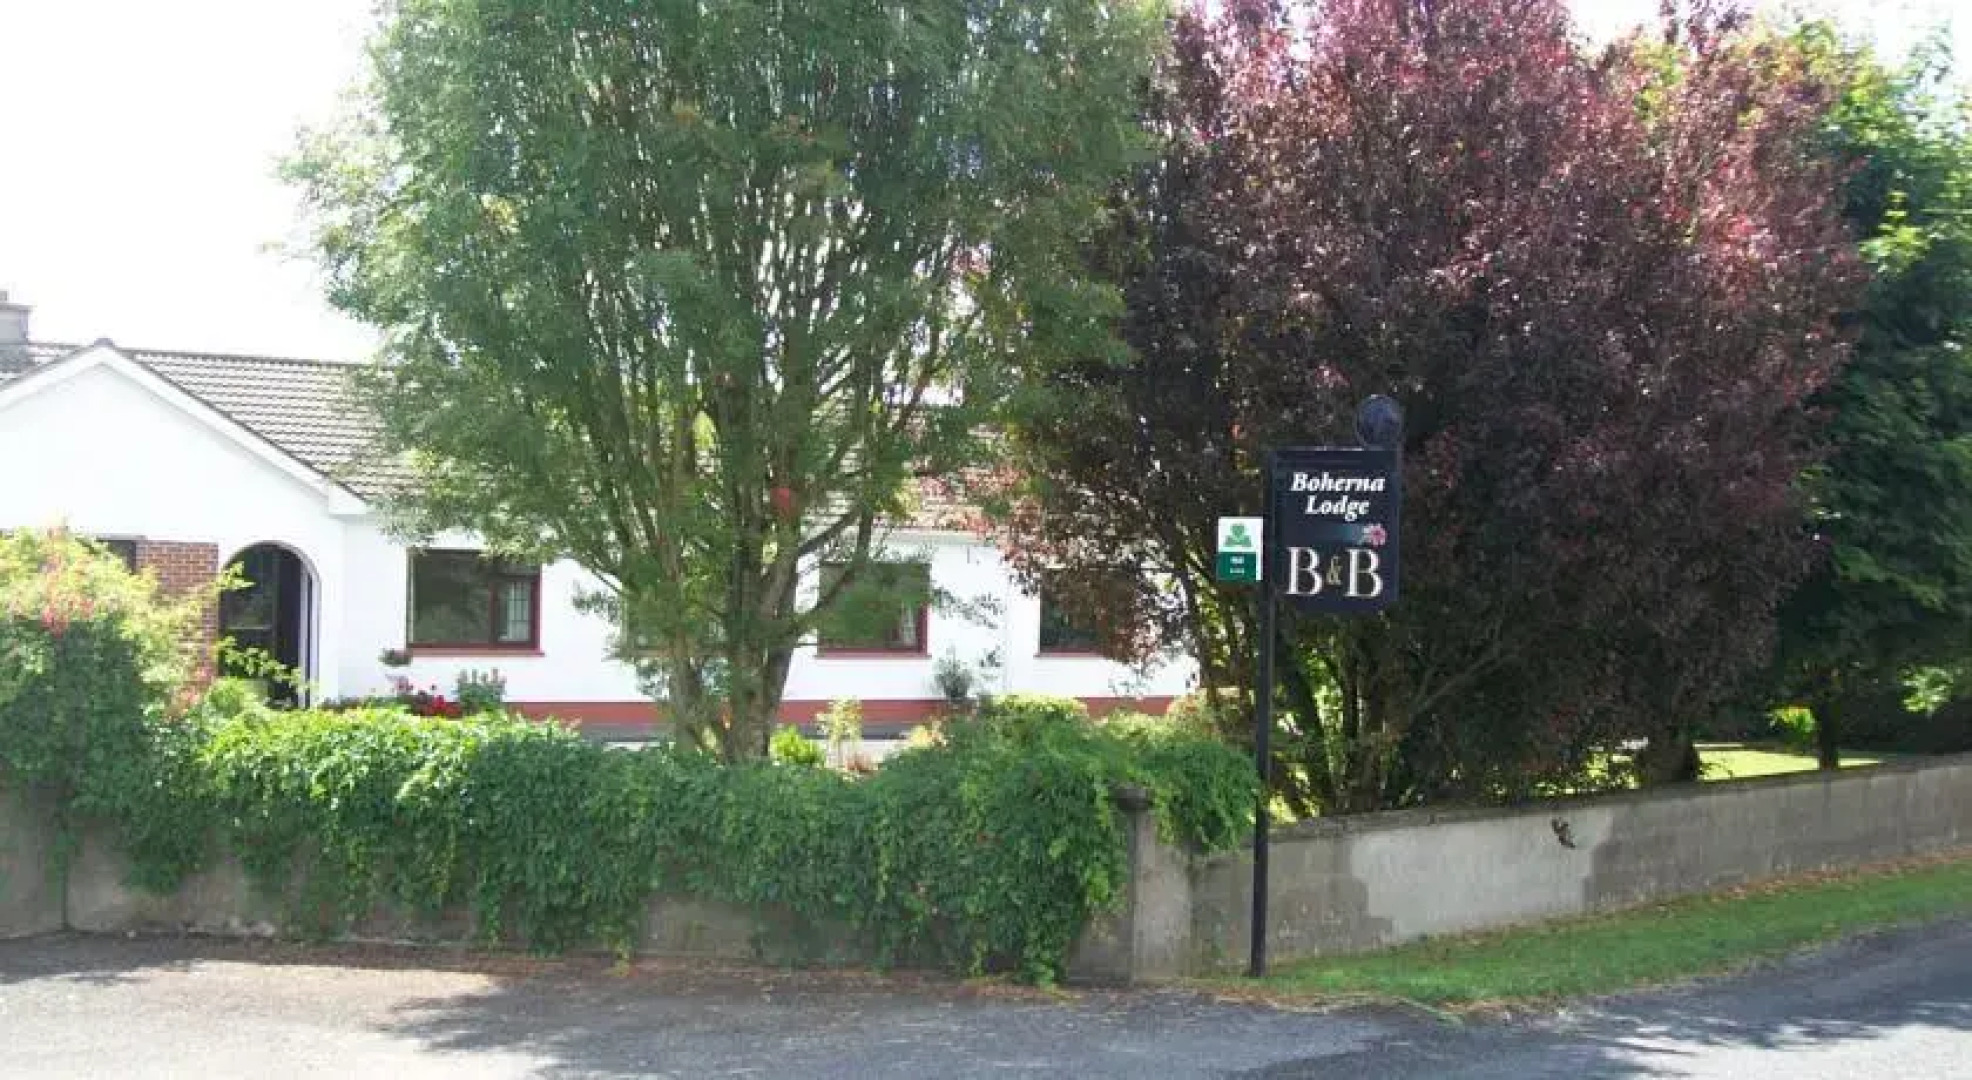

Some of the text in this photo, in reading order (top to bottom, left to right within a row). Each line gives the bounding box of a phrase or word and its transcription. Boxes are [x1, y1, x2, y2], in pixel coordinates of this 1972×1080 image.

[1291, 471, 1386, 492] Boherna
[1304, 495, 1370, 522] Lodge
[1286, 546, 1384, 598] B&B
